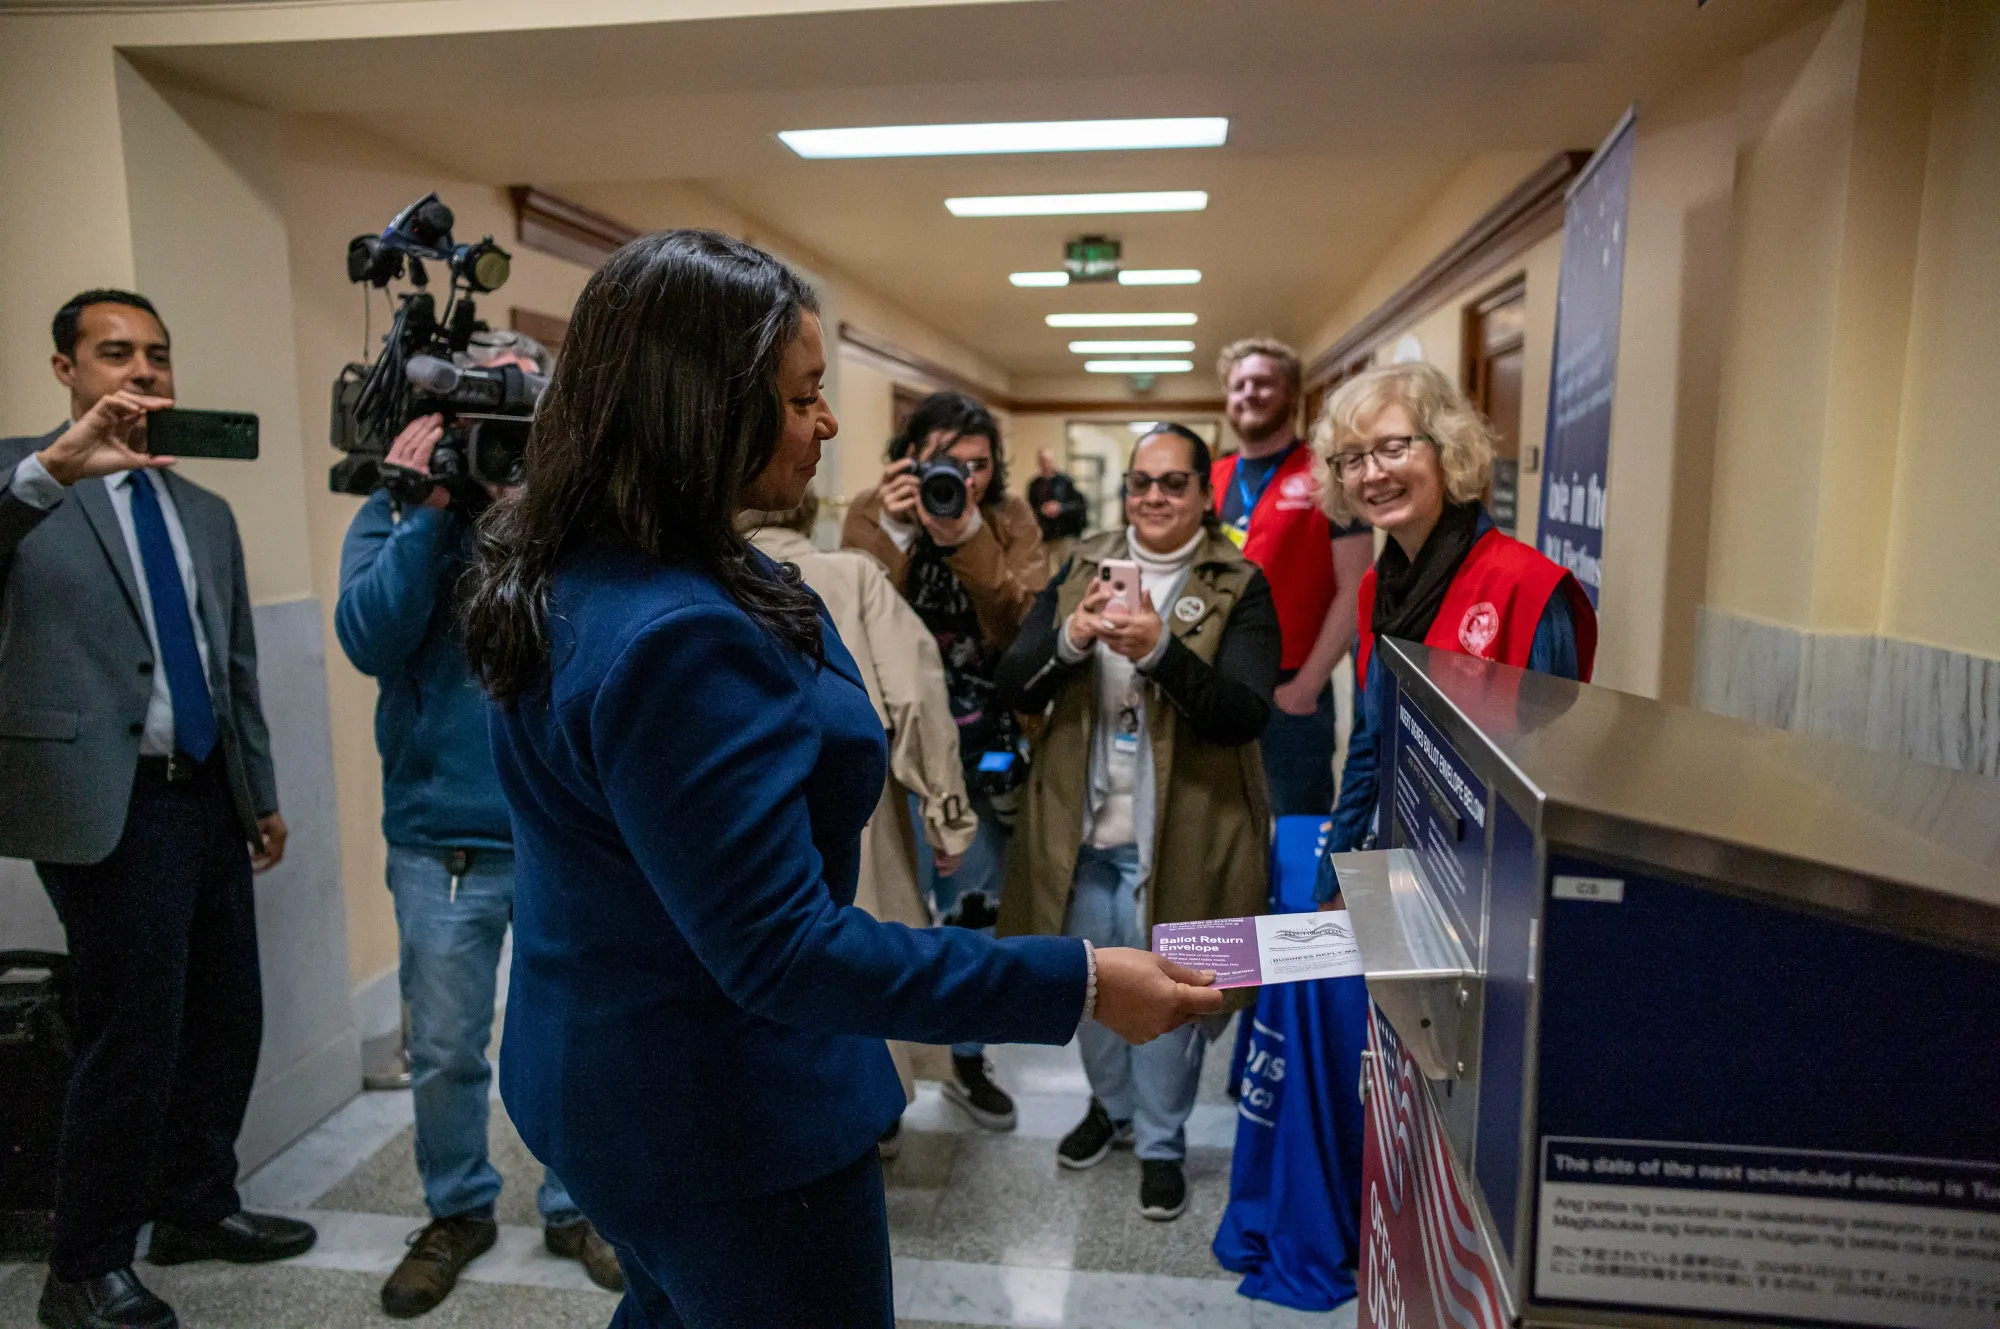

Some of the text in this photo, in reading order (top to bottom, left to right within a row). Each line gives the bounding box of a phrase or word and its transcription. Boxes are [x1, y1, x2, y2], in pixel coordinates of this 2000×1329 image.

[1423, 735, 1440, 768] BALLOT
[1439, 753, 1464, 801] ENVELOPE
[1463, 784, 1486, 828] BELOW
[1159, 944, 1219, 952] Envelope
[1160, 935, 1244, 944] Ballot Return
[1273, 954, 1314, 963] BUSINESS
[1554, 1153, 1590, 1172] The
[1592, 1155, 1635, 1175] date
[1638, 1158, 1660, 1176] of
[1662, 1160, 1695, 1178] the
[1699, 1164, 1742, 1181] next
[1746, 1166, 1850, 1186] scheduled
[1855, 1173, 1940, 1193] election
[1945, 1178, 1964, 1198] is
[1370, 1181, 1410, 1329] OFFICIA
